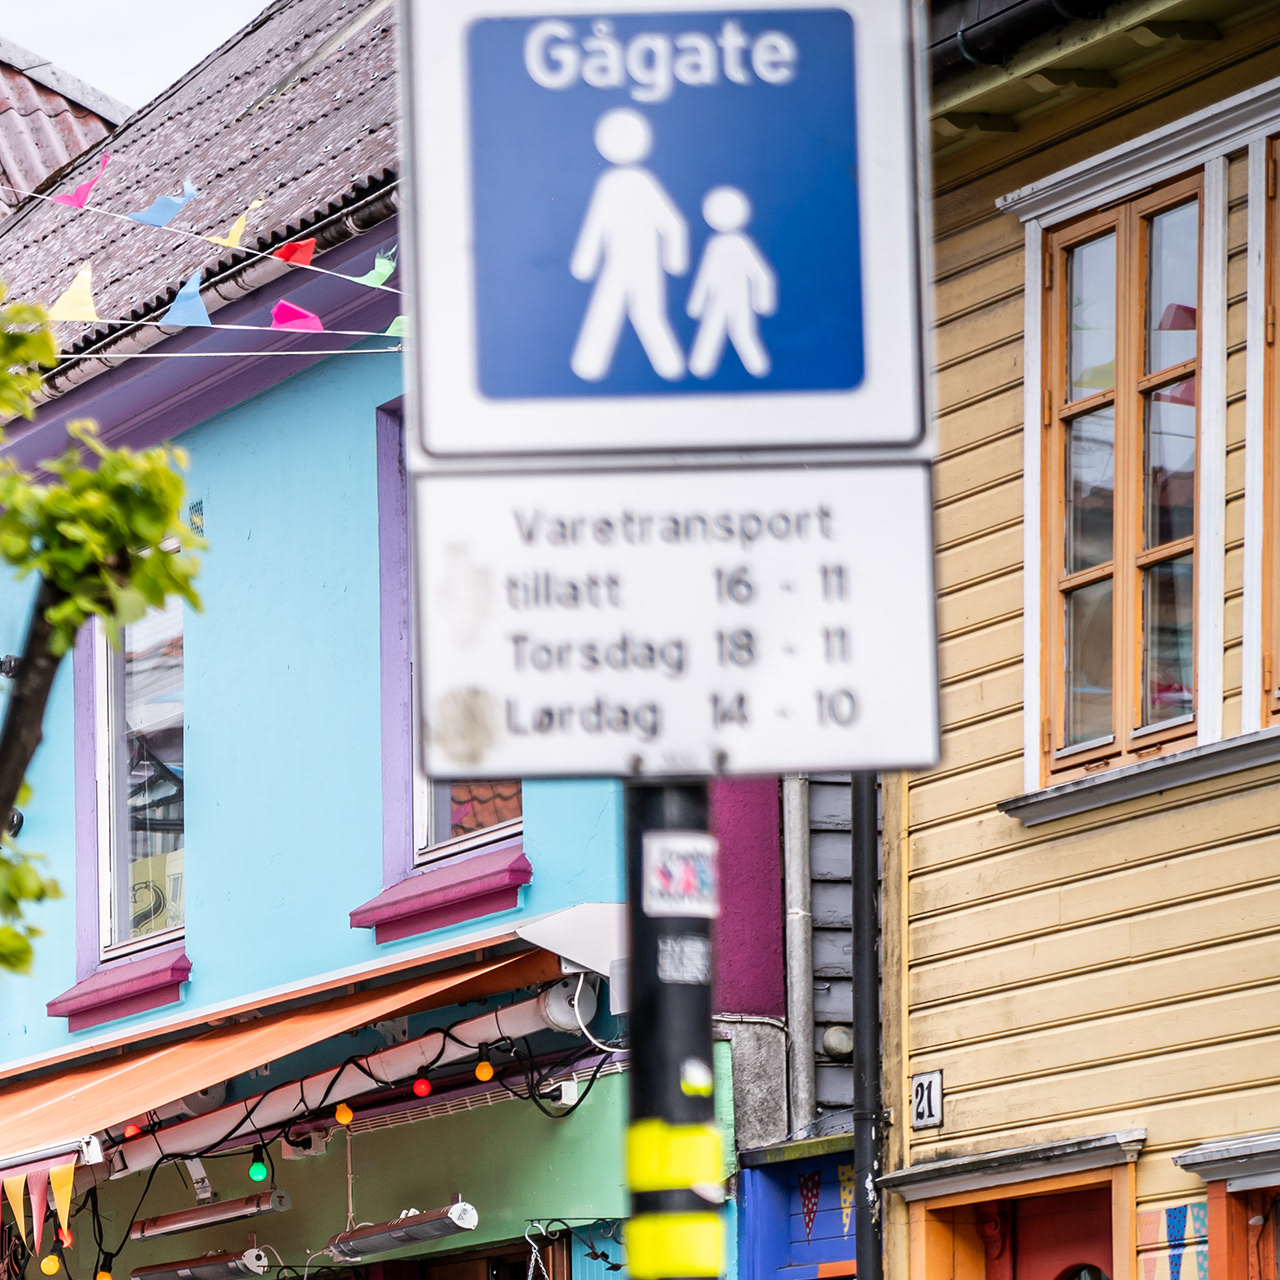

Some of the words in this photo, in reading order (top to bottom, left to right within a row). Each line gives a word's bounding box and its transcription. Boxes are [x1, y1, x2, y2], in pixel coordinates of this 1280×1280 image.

[523, 19, 797, 103] Gågate
[512, 503, 832, 551] Varetransport
[506, 569, 622, 610] tillatt
[714, 565, 755, 605] 16
[820, 564, 844, 602] 11
[509, 633, 686, 679] Torsdag
[715, 629, 757, 668] 18
[823, 627, 848, 664] 11
[505, 696, 661, 743] Lørdag
[711, 691, 748, 730] 14
[817, 689, 857, 727] 10
[915, 1080, 935, 1121] 21
